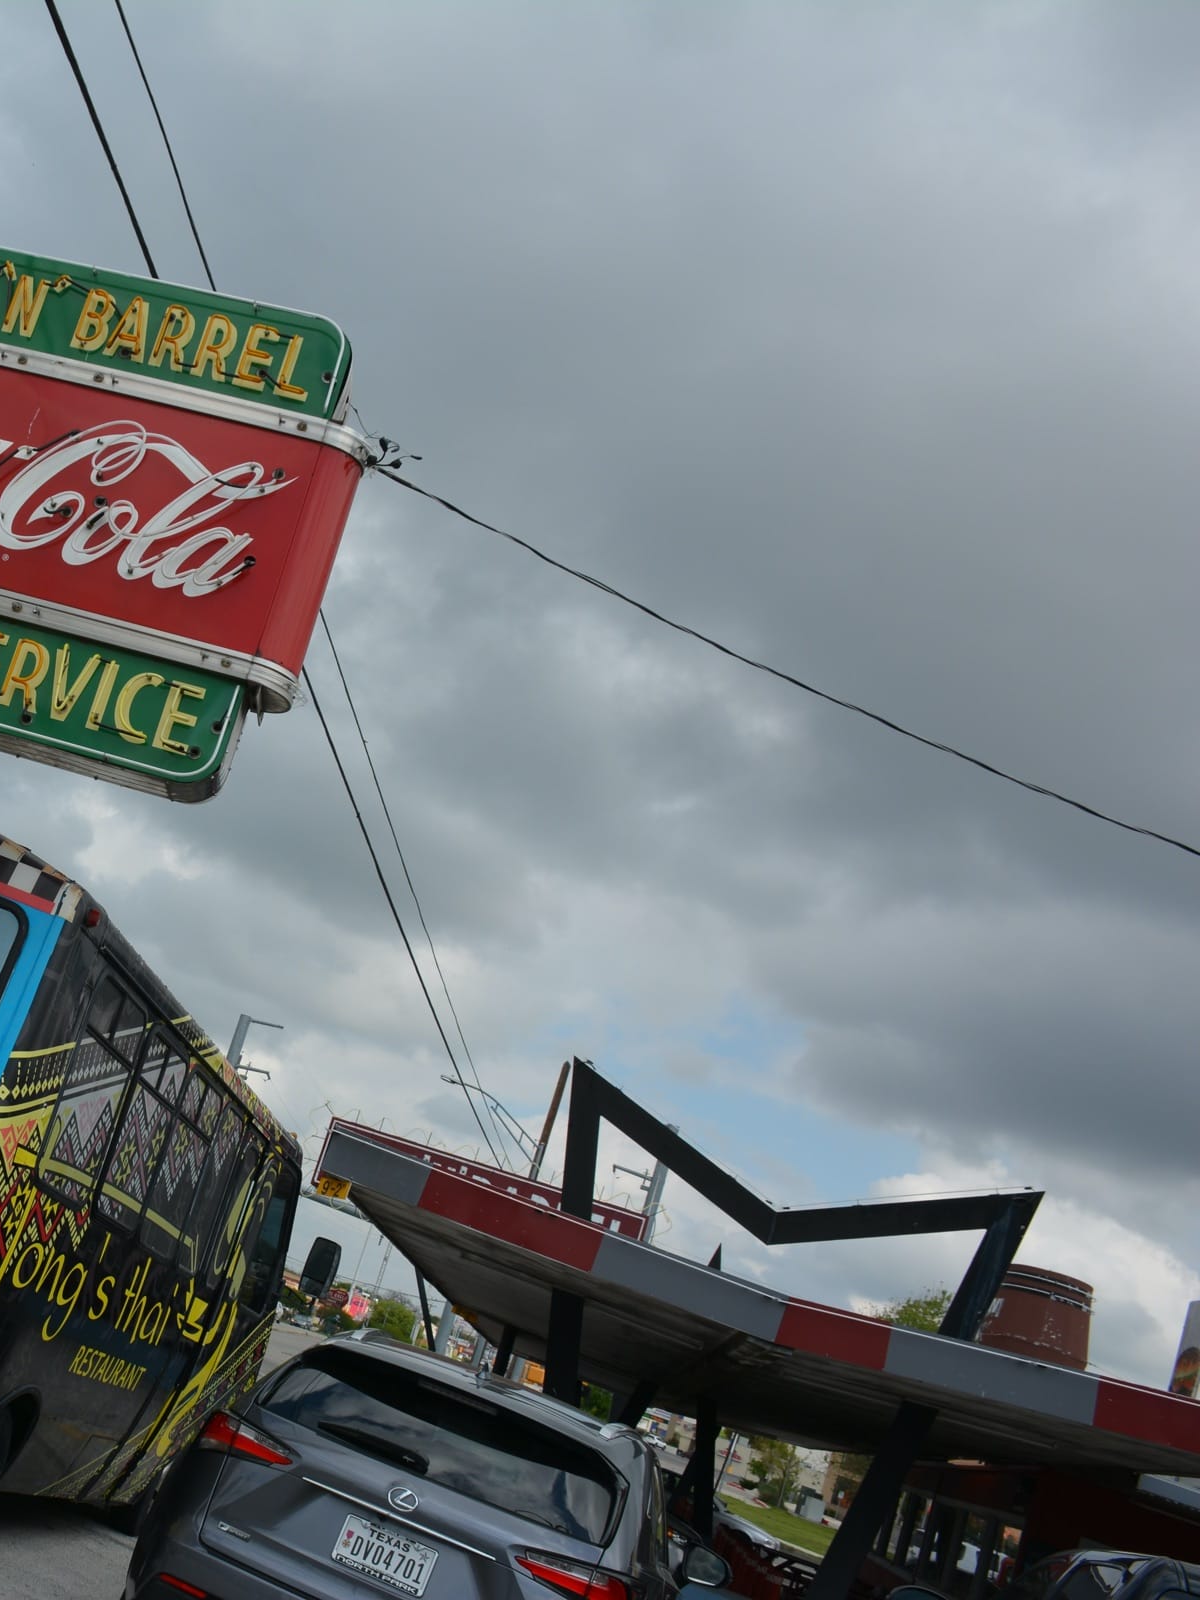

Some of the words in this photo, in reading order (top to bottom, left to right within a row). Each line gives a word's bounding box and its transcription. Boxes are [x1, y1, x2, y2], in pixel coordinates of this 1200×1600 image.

[70, 288, 309, 402] BARREL
[114, 1256, 180, 1346] thai
[68, 1345, 147, 1391] RESTAURANT
[350, 1535, 425, 1585] DV04701
[368, 1528, 411, 1553] TEXAS
